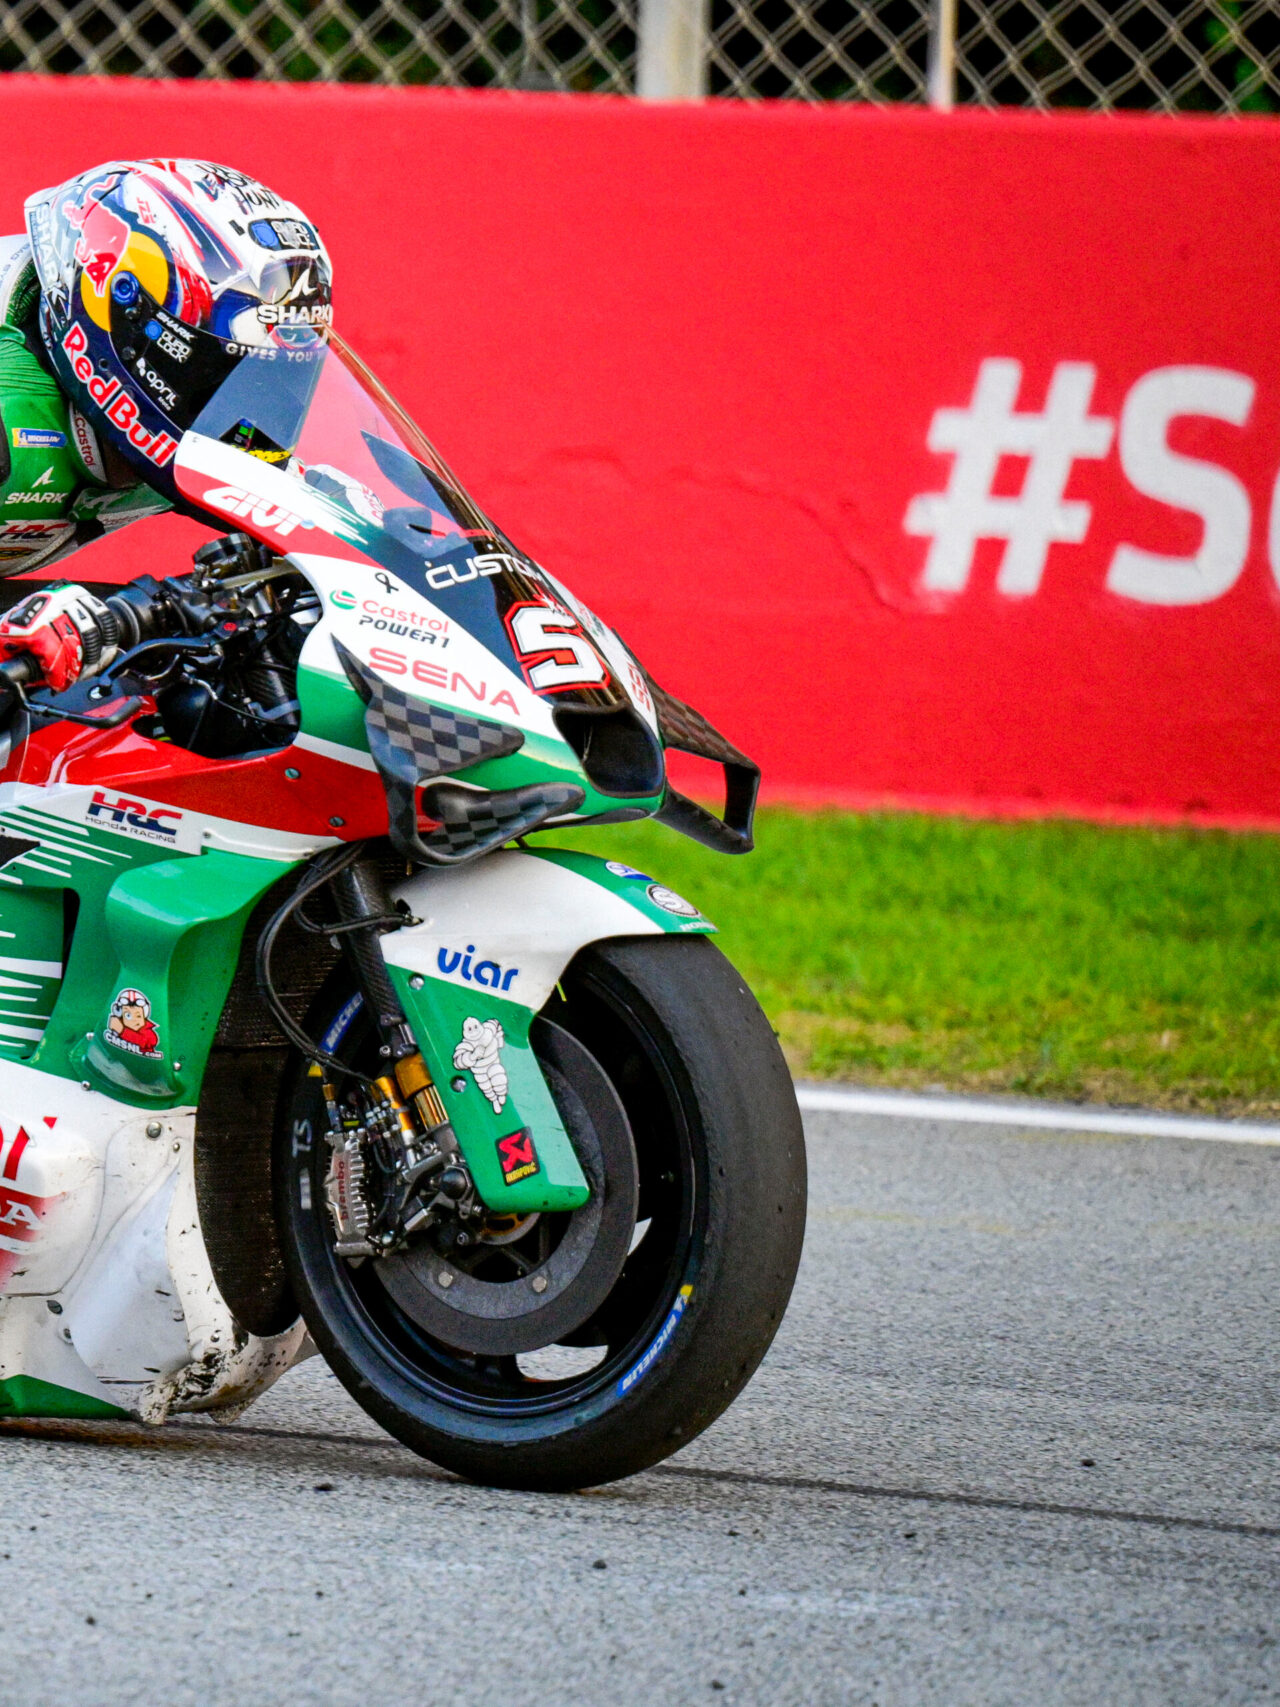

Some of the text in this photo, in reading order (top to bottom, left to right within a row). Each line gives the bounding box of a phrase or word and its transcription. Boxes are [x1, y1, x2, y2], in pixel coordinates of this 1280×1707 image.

[156, 311, 198, 342] SHARK
[257, 305, 333, 325] SHARK
[156, 338, 188, 363] LOCK
[161, 330, 192, 356] QUAD
[226, 343, 314, 362] GIVES YOU
[61, 321, 120, 409] Red
[104, 391, 180, 468] Bull
[146, 370, 178, 407] april
[75, 418, 96, 467] Castrol
[4, 492, 69, 505] SHARK
[203, 486, 304, 536] GIVI
[362, 599, 449, 633] Castrol
[368, 646, 521, 714] SENA
[85, 815, 177, 843] Honda RACING
[87, 791, 183, 836] HRC
[437, 944, 519, 991] viar
[336, 1161, 348, 1221] brembo
[622, 1313, 677, 1391] MICHELIN
